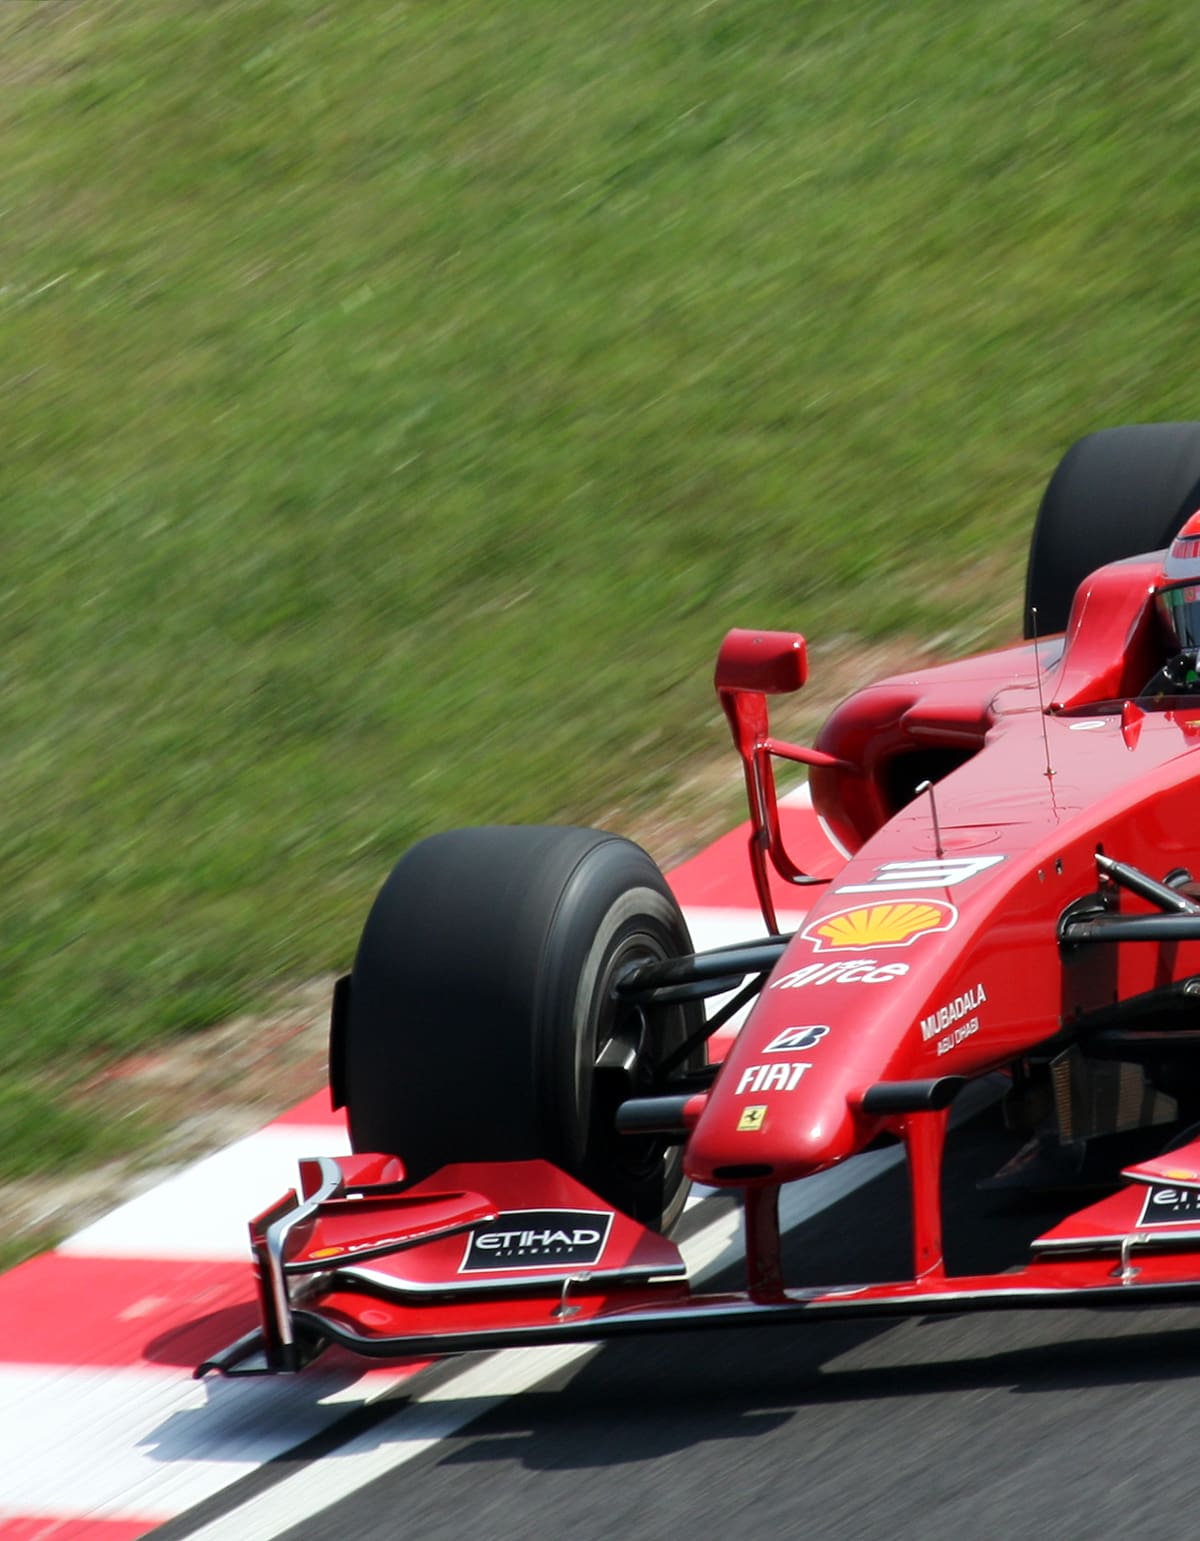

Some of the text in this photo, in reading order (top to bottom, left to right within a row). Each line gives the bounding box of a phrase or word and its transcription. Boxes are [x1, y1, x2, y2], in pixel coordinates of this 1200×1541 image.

[769, 958, 910, 990] Alice
[920, 983, 987, 1042] MUBADALA
[937, 1016, 980, 1057] ABU DHABI
[734, 1062, 813, 1096] FIAT
[475, 1229, 601, 1250] ETIHAD
